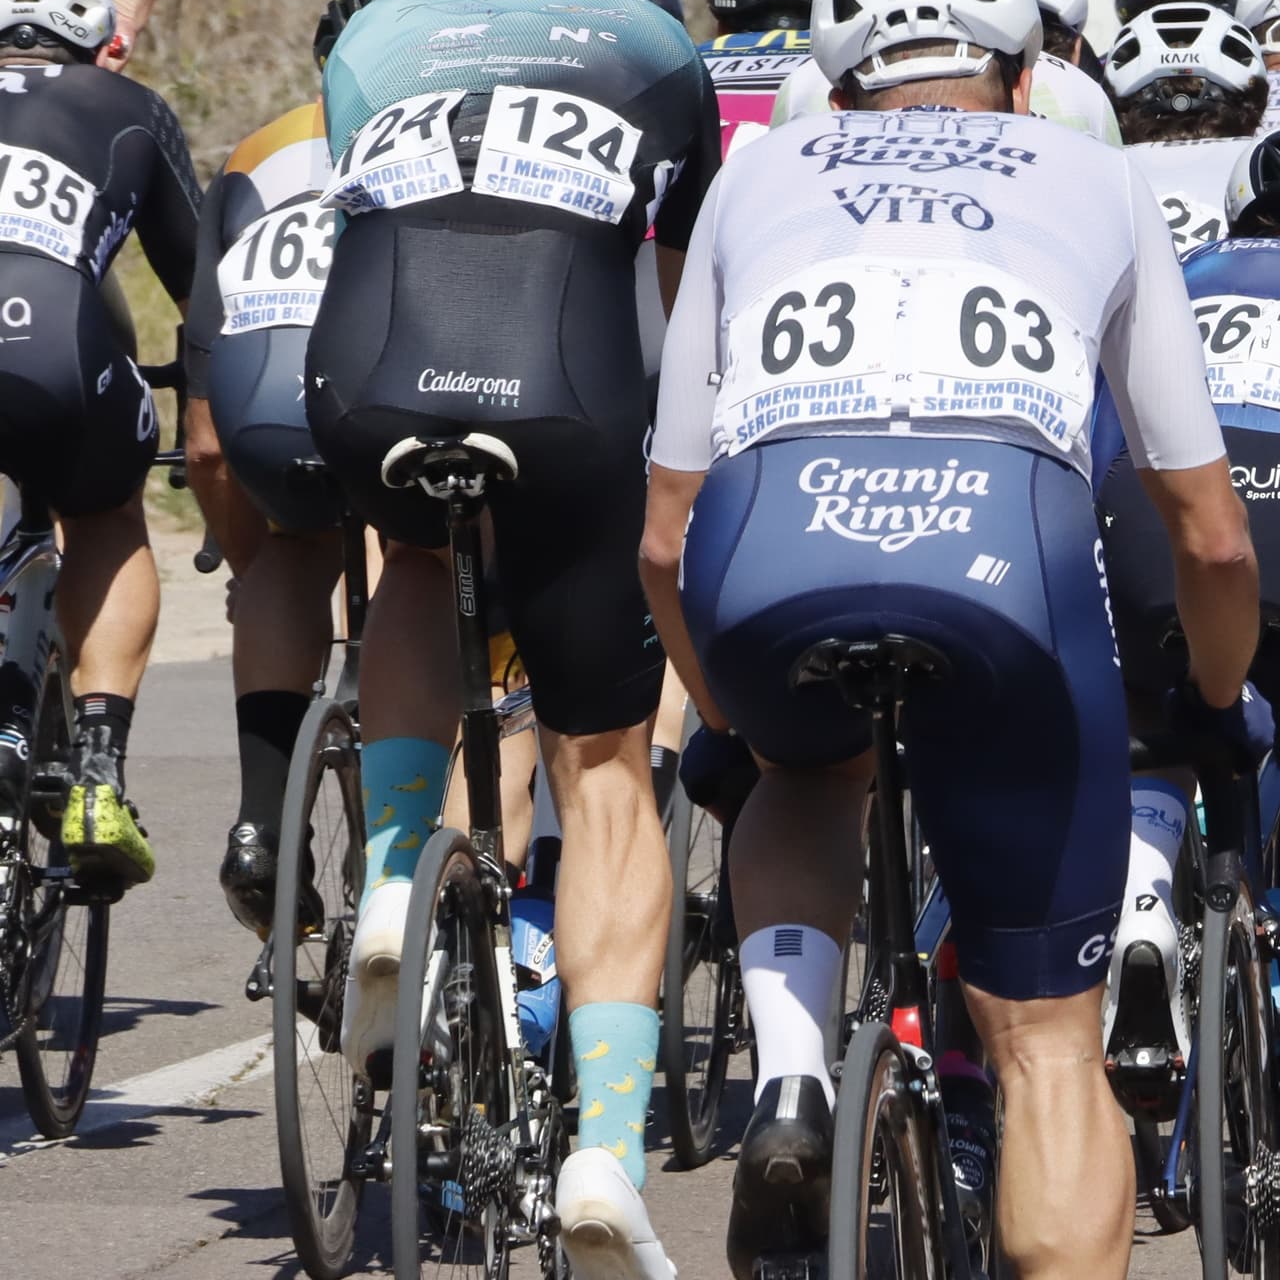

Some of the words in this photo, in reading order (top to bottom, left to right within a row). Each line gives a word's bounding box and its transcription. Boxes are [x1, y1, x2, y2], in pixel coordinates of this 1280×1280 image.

[508, 96, 626, 176] 124
[800, 132, 1038, 165] Granja
[514, 159, 611, 197] MEMORIAL
[818, 146, 1017, 179] Rinya
[393, 173, 452, 202] BAEZA
[841, 196, 995, 232] VITO
[25, 231, 70, 258] BAEZA
[242, 210, 335, 282] 163
[243, 291, 323, 308] MEMORIA
[761, 282, 856, 375] 63
[960, 286, 1056, 373] 63
[1195, 303, 1261, 355] 56
[418, 368, 521, 396] Calderona
[755, 377, 866, 411] MEMORIAL
[953, 379, 1064, 414] MEMORIAL
[478, 395, 520, 408] BIKE
[736, 401, 800, 445] SERGIO
[809, 395, 878, 417] BAEZA
[923, 396, 1003, 412] SERGIO
[1013, 399, 1069, 441] BAEZA
[798, 457, 990, 503] Granja
[1246, 490, 1275, 501] Sport
[805, 496, 973, 553] Rinya
[457, 552, 476, 616] BMC
